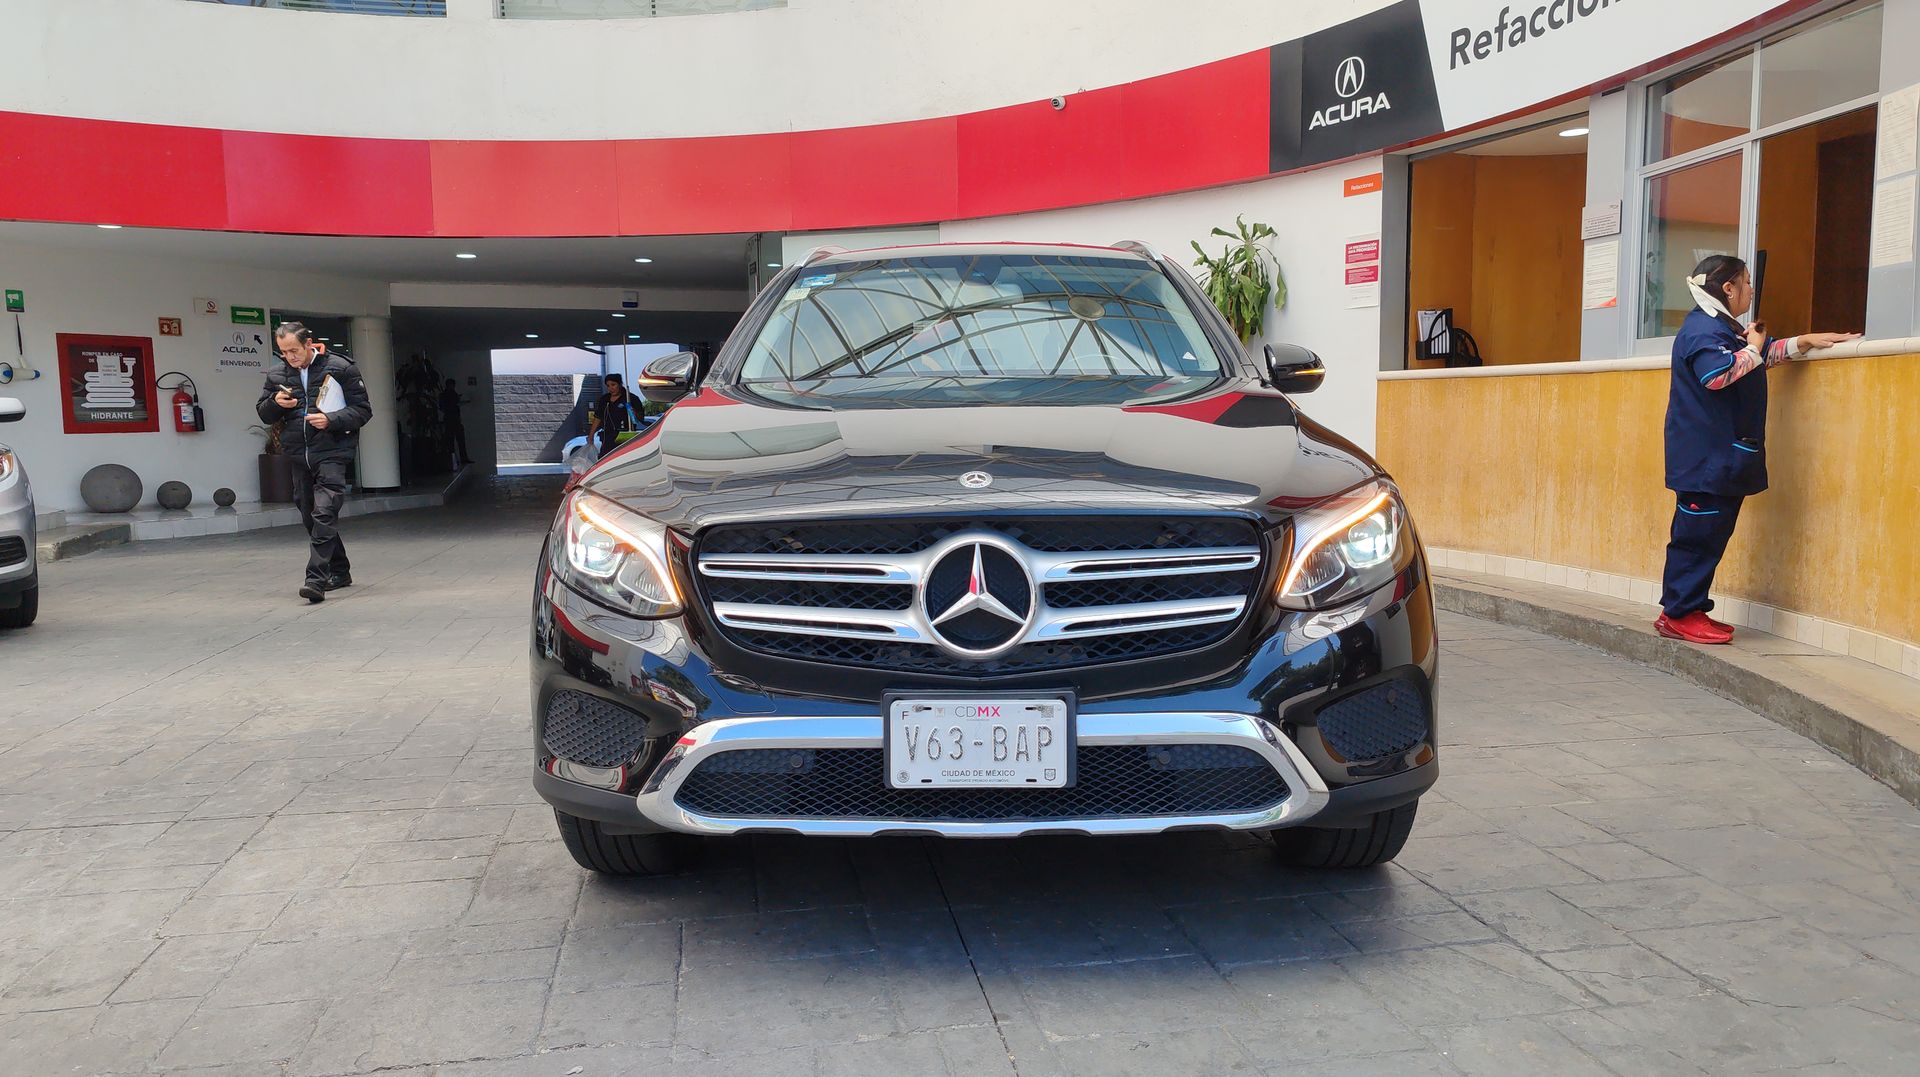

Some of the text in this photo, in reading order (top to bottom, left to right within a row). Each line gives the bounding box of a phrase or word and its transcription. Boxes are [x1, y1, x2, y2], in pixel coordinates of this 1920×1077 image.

[1308, 92, 1391, 131] ACURA
[222, 346, 258, 354] ACURA
[220, 359, 261, 367] BIENVENIDOS
[902, 711, 909, 720] F
[954, 705, 1001, 718] CDMX
[904, 725, 1053, 762] V63-BAP
[941, 768, 1016, 777] CIUDAD DE MÉXICO
